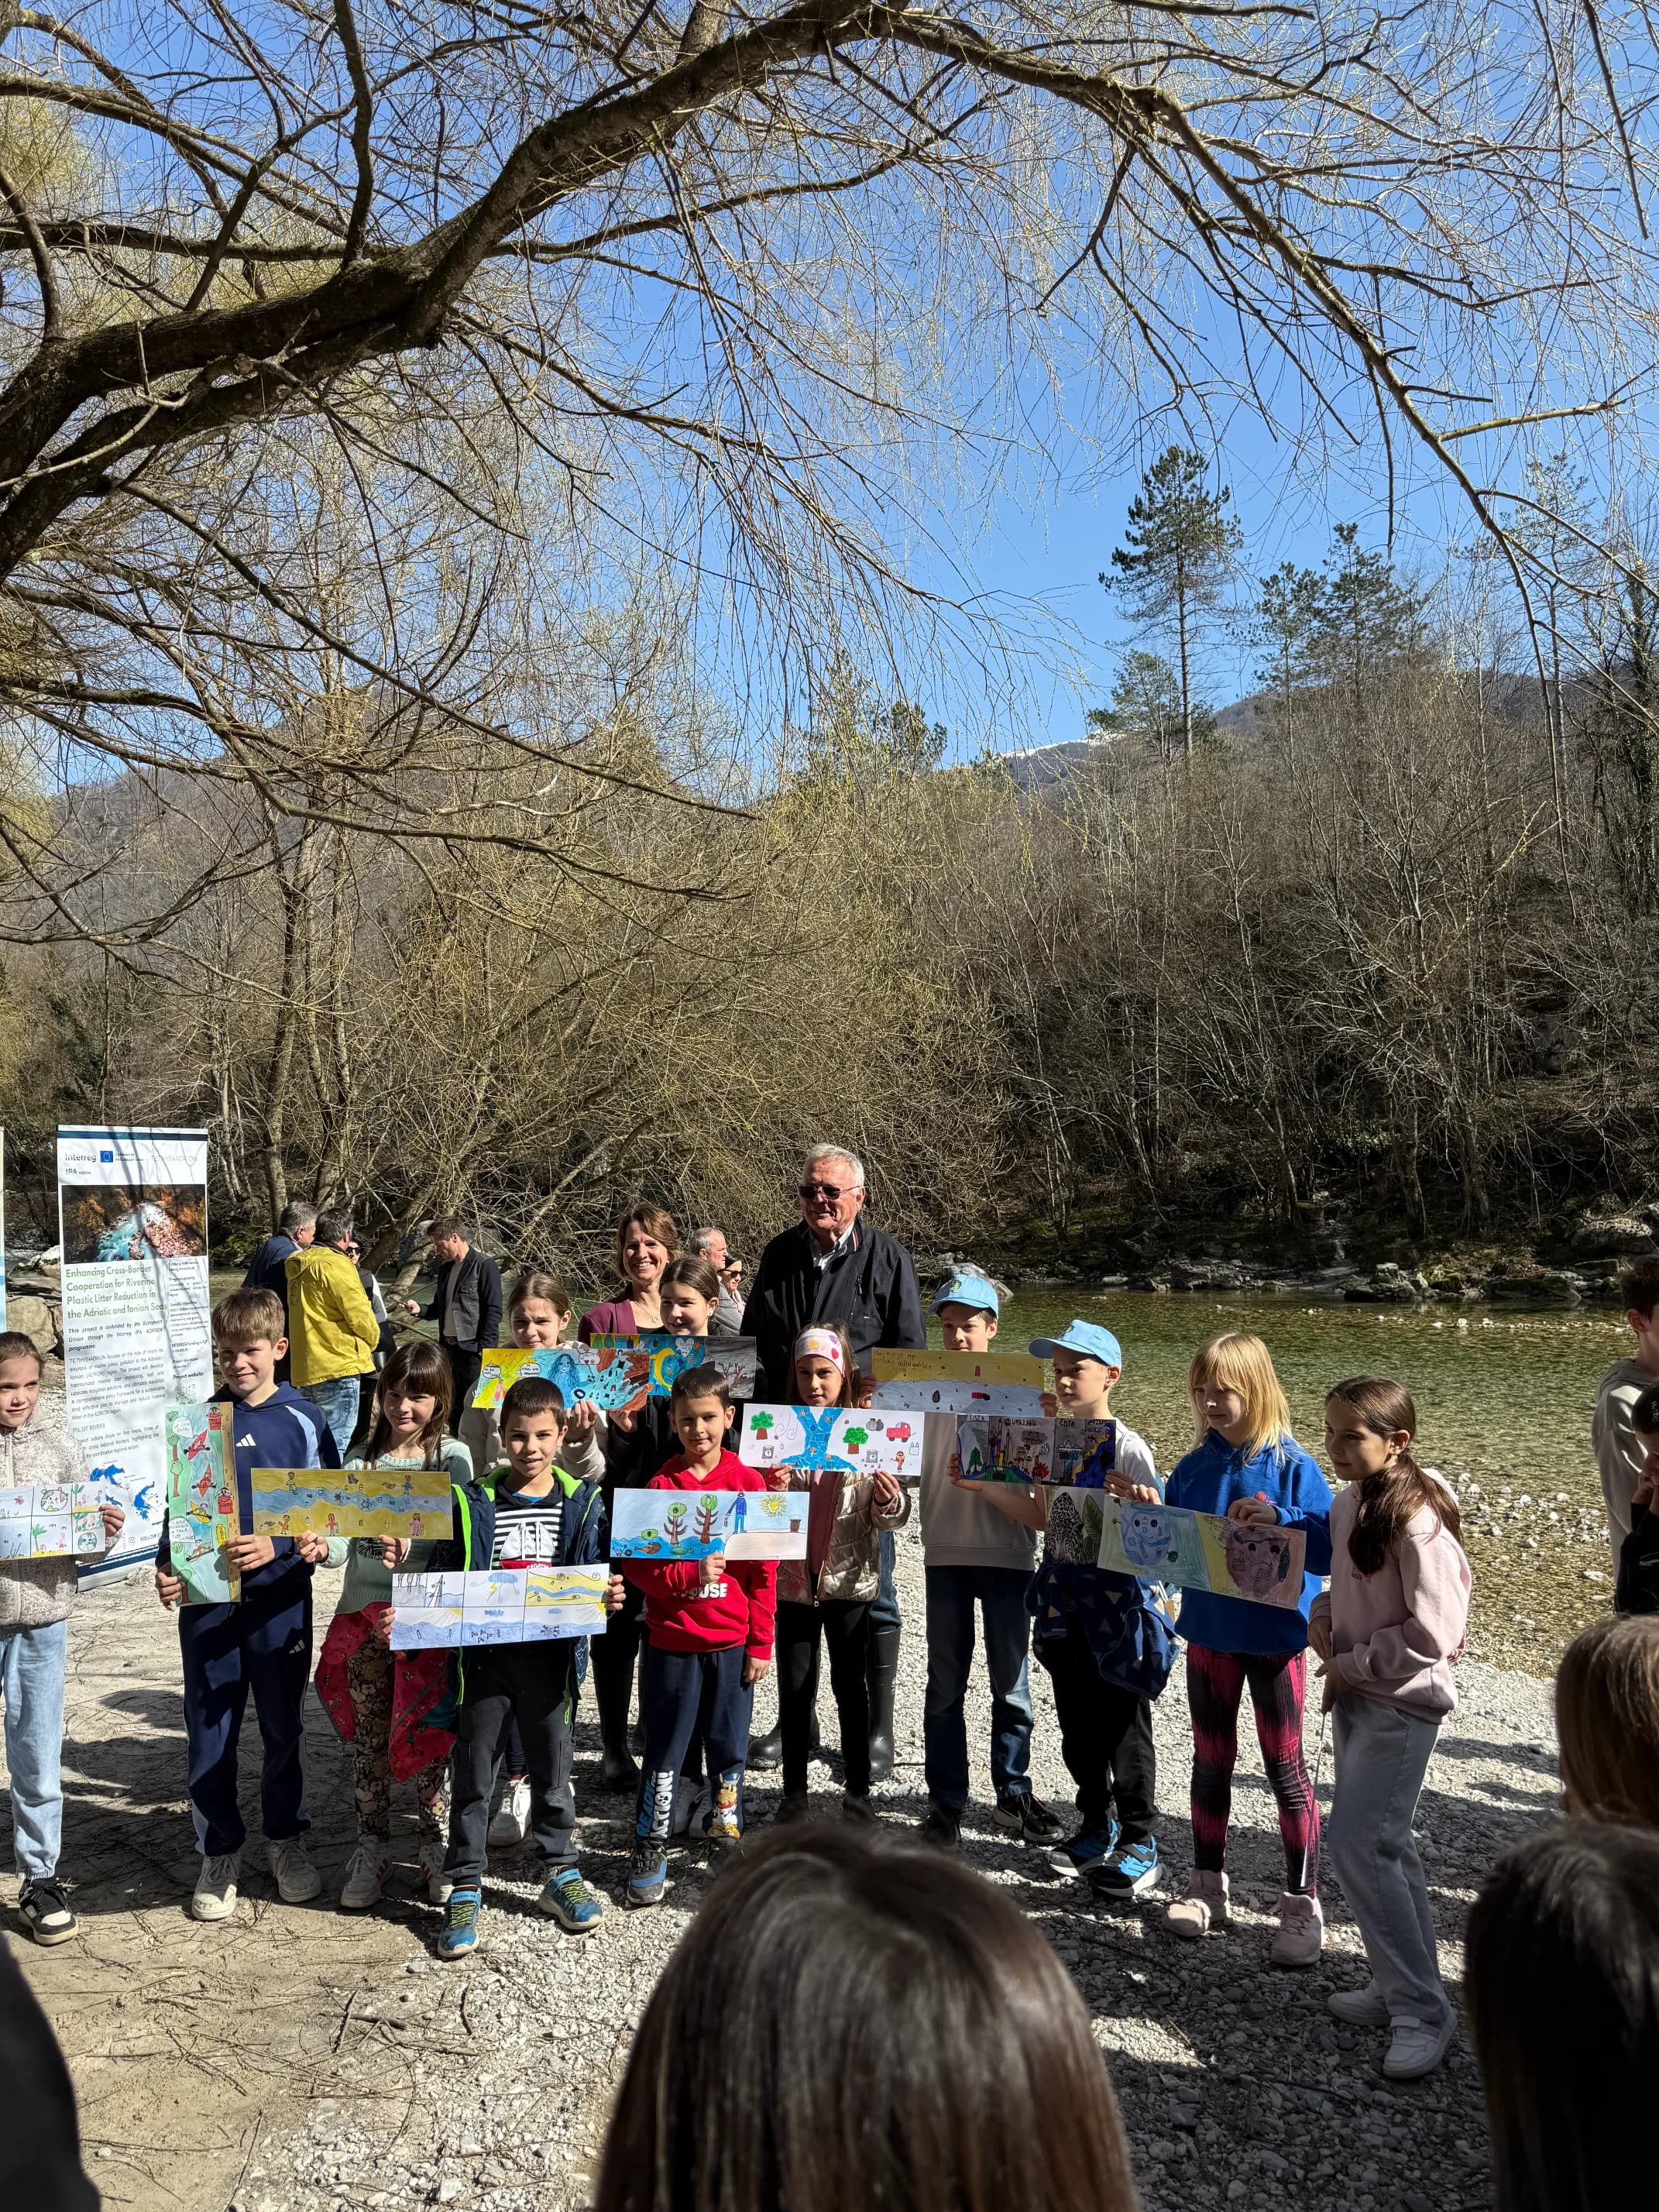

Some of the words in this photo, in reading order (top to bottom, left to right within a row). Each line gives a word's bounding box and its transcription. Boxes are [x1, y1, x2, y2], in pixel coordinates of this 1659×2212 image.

[65, 1152, 97, 1163] Interreg
[66, 1268, 105, 1278] Enhancing
[106, 1266, 152, 1275] Cross-Border
[66, 1280, 114, 1293] Cooperation
[115, 1279, 125, 1287] for
[126, 1277, 155, 1286] Riverine
[67, 1295, 94, 1305] Plastic
[94, 1293, 113, 1303] Litter
[114, 1291, 148, 1301] Reduction
[67, 1310, 81, 1319] the
[83, 1307, 112, 1317] Adriatic
[112, 1304, 125, 1314] and
[127, 1304, 149, 1313] Ionian
[150, 1302, 168, 1310] Seas
[637, 1778, 655, 1837] READY
